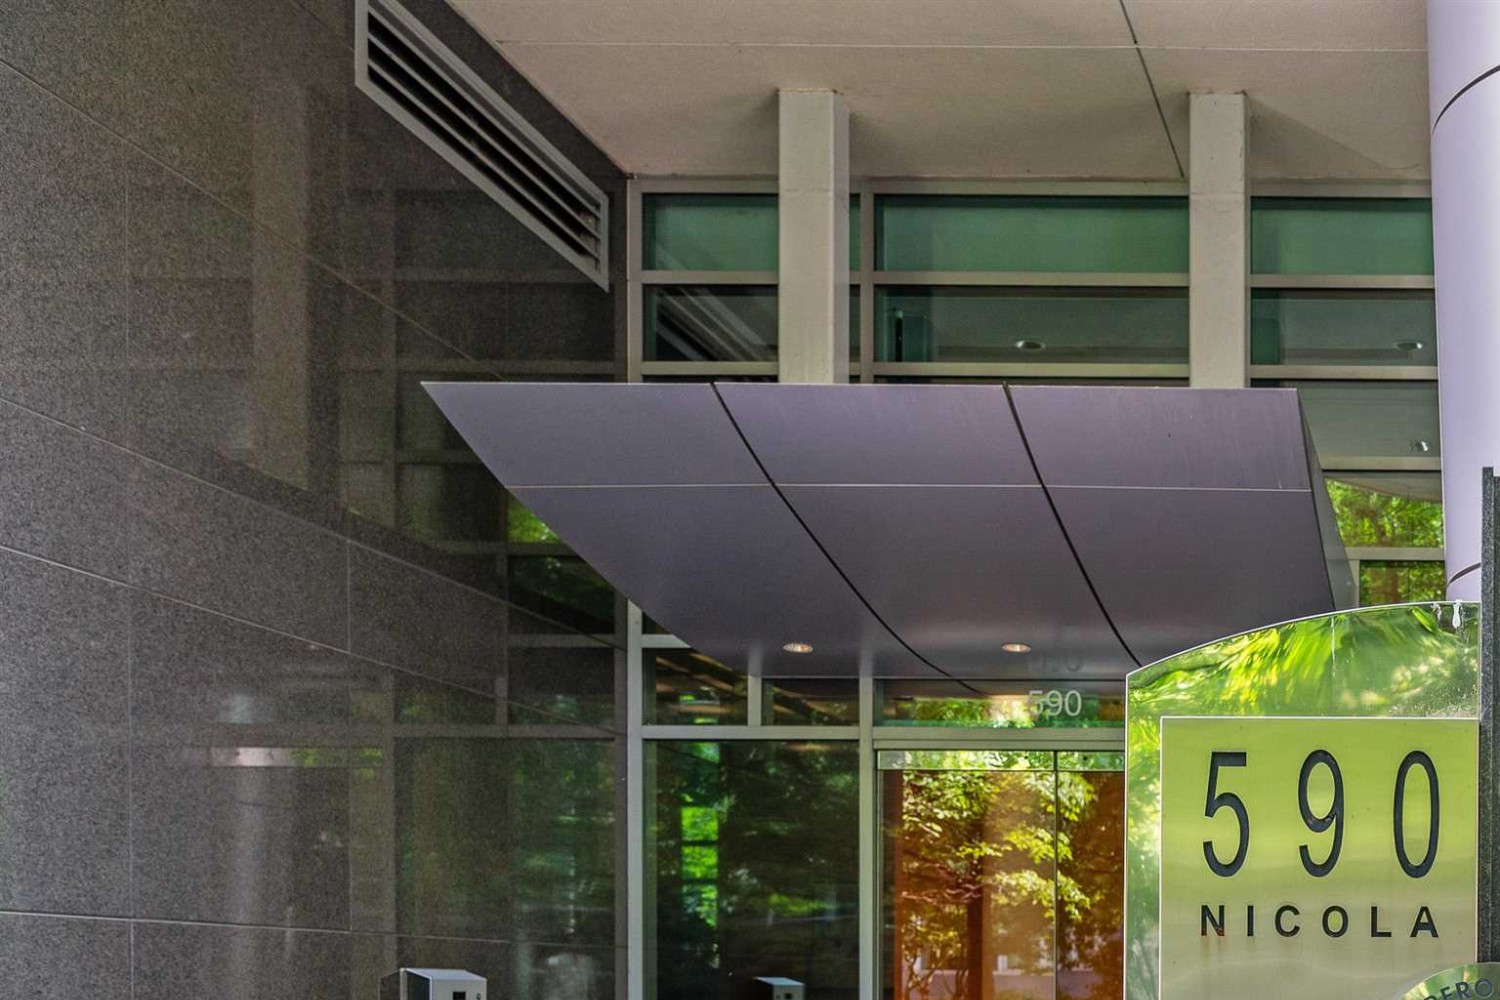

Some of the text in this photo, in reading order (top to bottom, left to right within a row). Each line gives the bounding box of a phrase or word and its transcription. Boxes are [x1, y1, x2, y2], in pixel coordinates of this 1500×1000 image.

[1026, 690, 1082, 717] 590
[1202, 749, 1440, 879] 590
[1200, 904, 1440, 938] NICOLA
